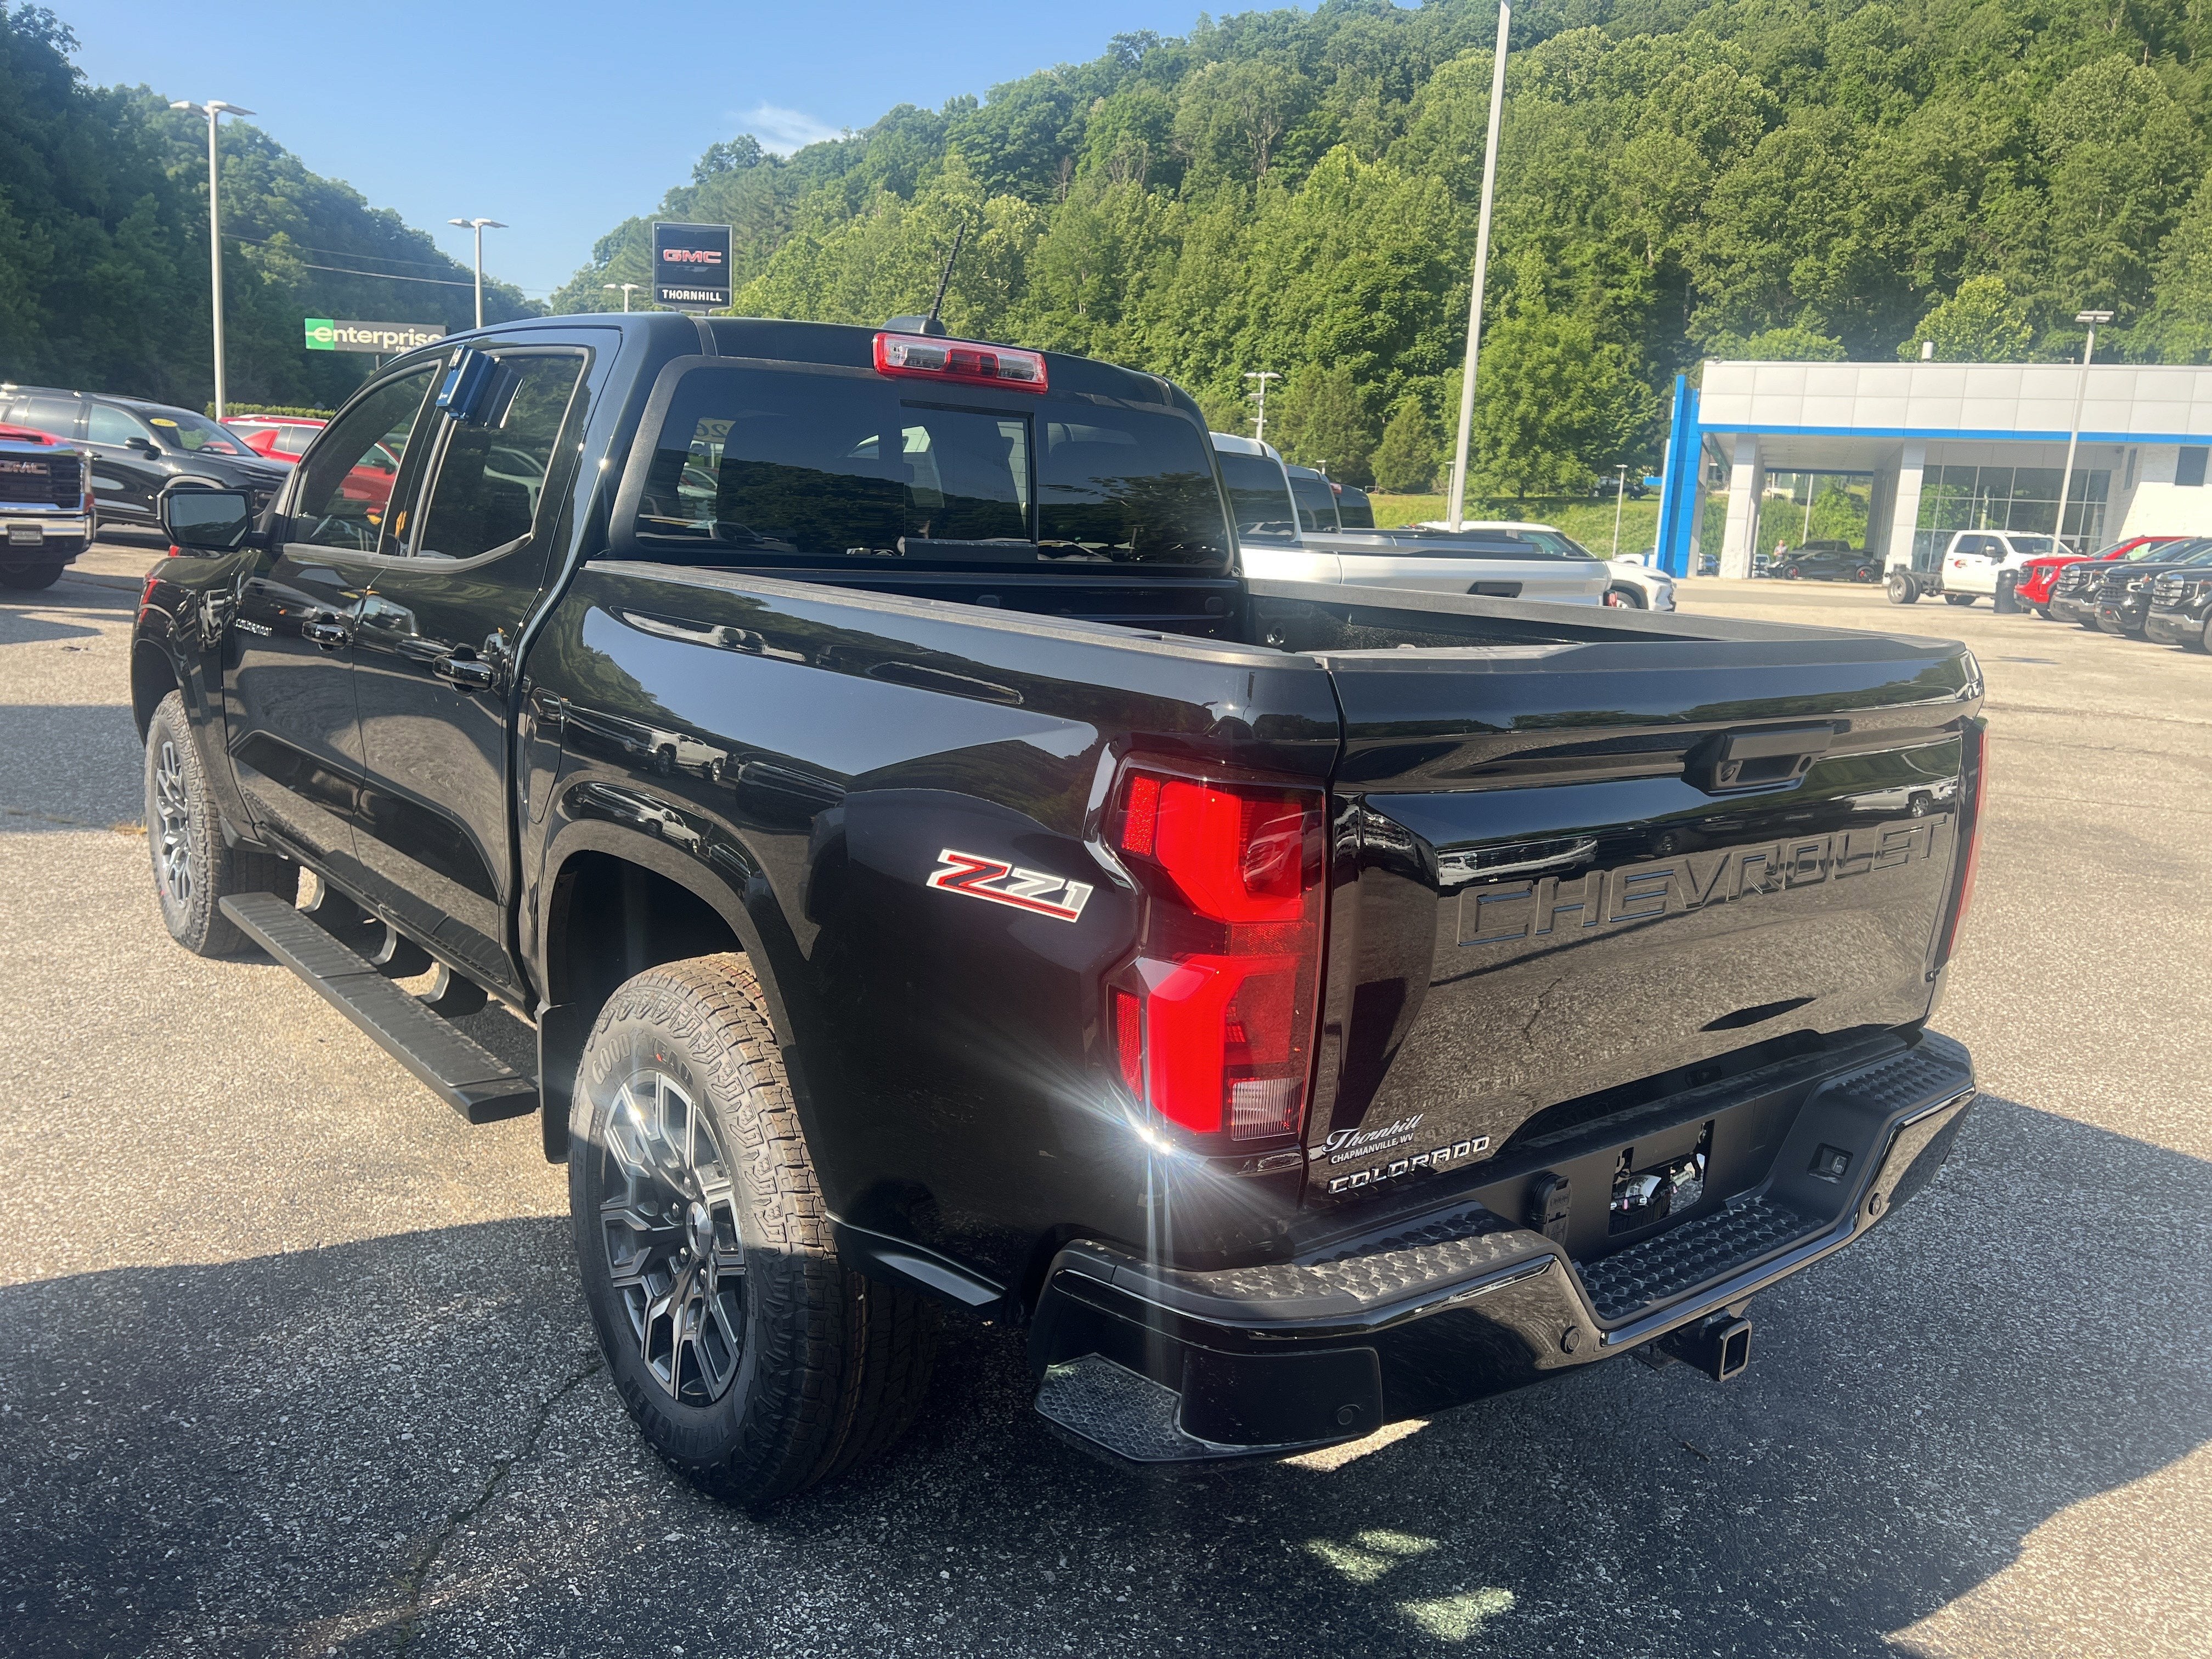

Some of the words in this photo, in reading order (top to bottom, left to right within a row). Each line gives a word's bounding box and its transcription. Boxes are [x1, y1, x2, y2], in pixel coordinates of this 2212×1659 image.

[663, 249, 721, 263] GMC
[662, 289, 722, 301] THORNHILL
[926, 848, 1092, 923] Z71
[1457, 814, 1948, 946] CHEVROLET
[1322, 1113, 1424, 1152] Thornhill
[1331, 1138, 1399, 1164] CHAPMANVILLE,
[1400, 1132, 1414, 1143] WV
[1328, 1136, 1490, 1194] COLORADO
